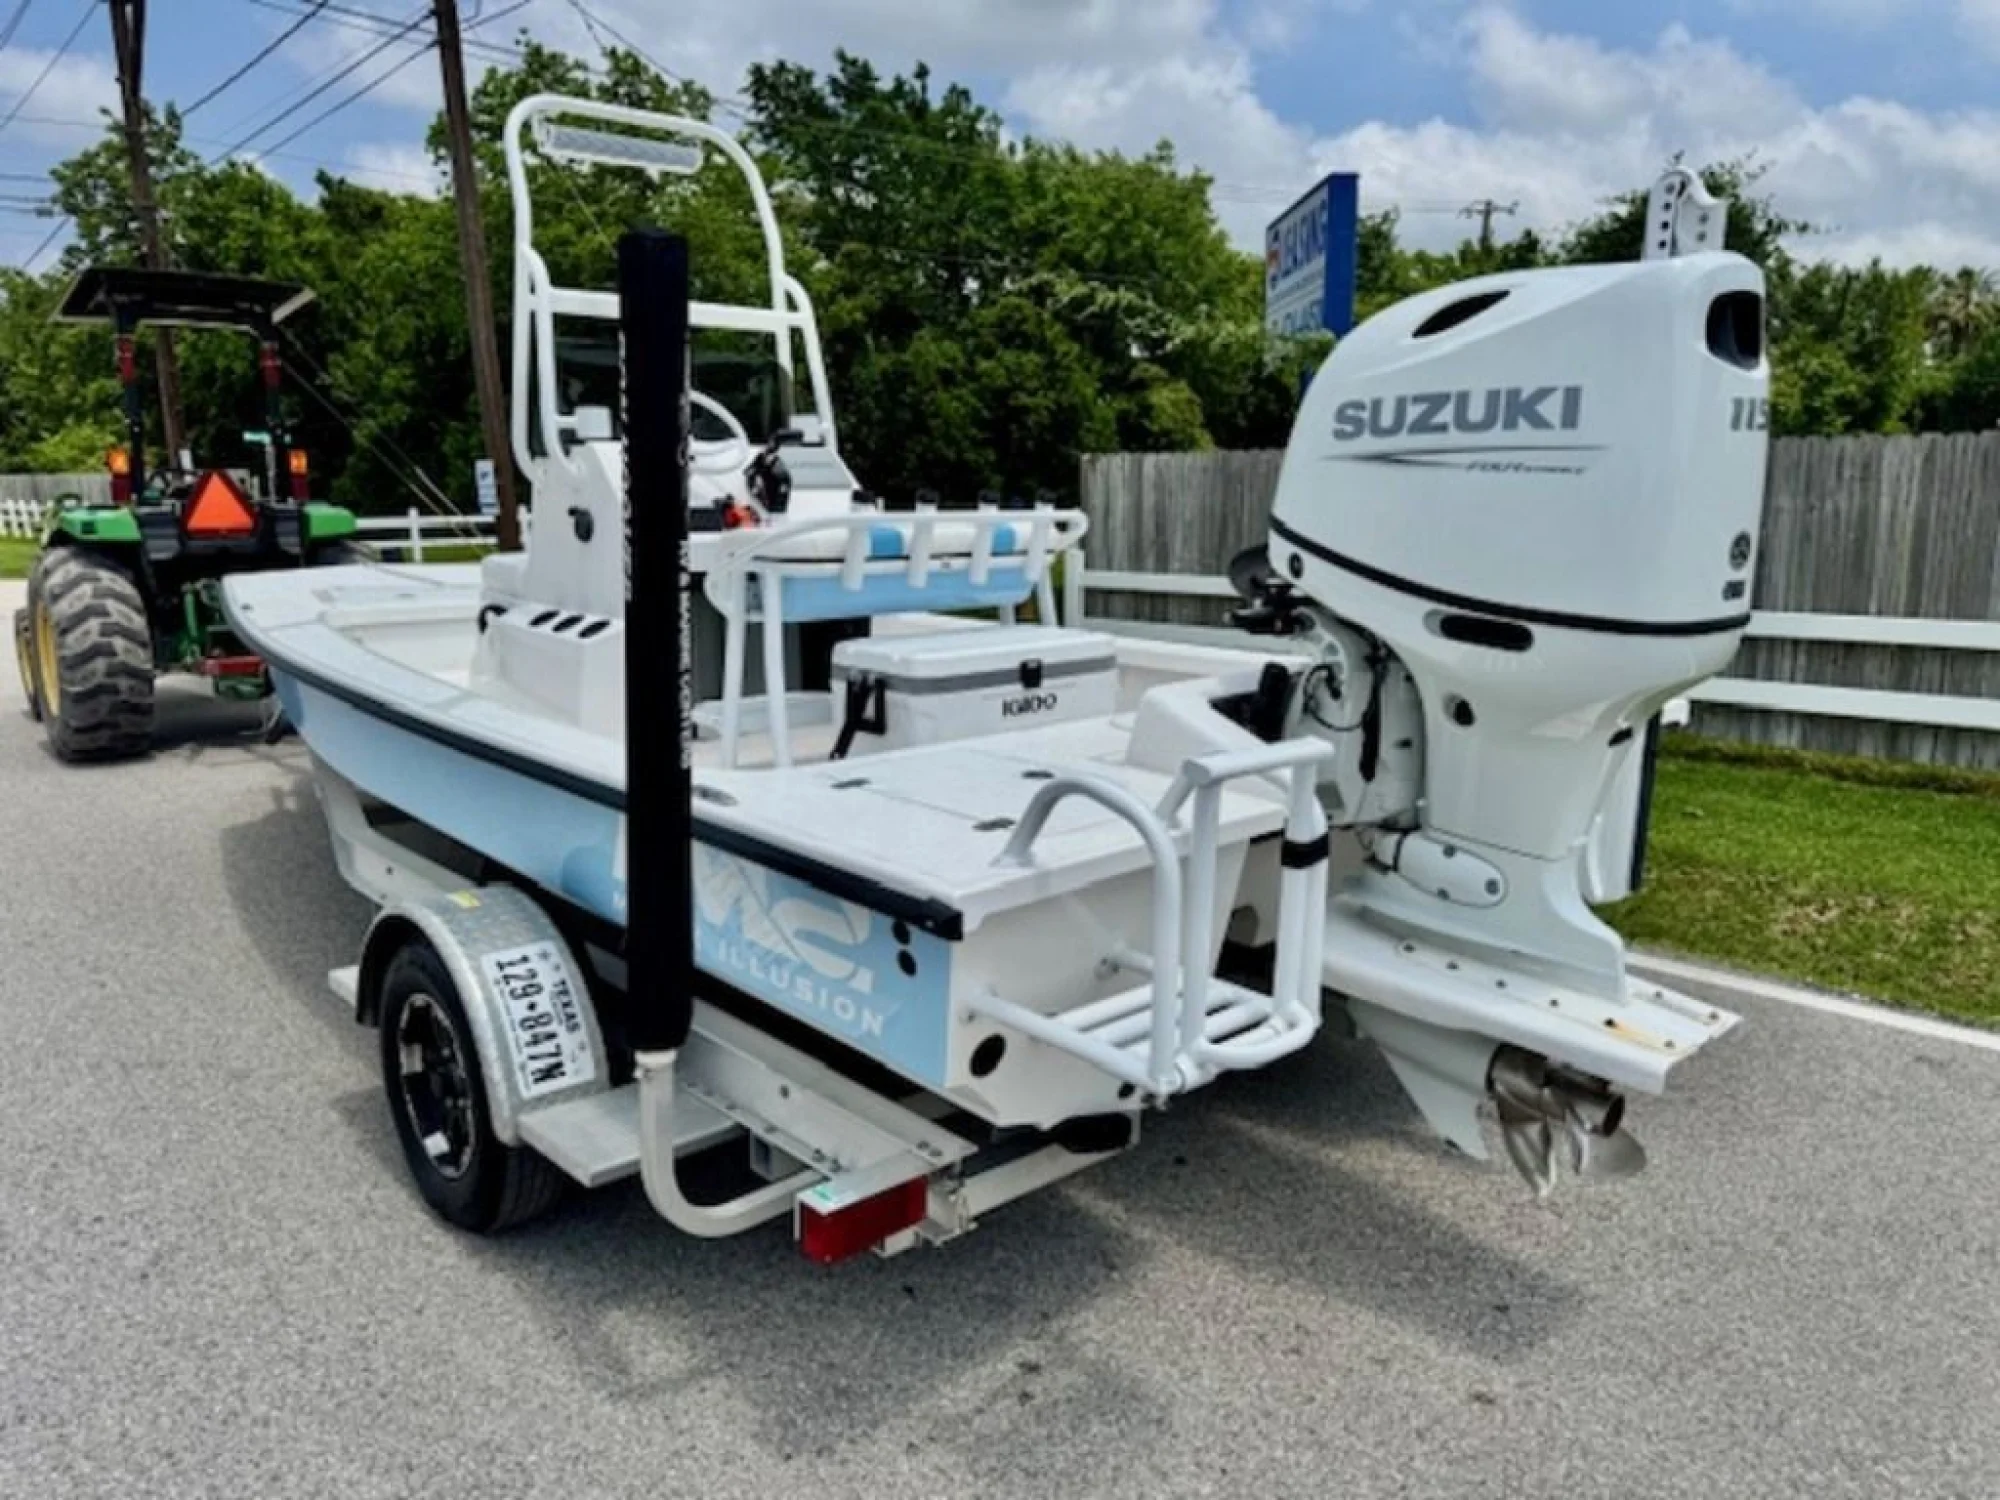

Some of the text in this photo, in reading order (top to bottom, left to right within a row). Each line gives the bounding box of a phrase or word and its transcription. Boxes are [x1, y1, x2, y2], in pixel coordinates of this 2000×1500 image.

[1332, 384, 1582, 441] SUZUKI
[1730, 396, 1769, 431] 115
[1002, 692, 1057, 718] IGLOO
[552, 977, 581, 1033] TEXAS
[718, 938, 886, 1038] ILLUSION
